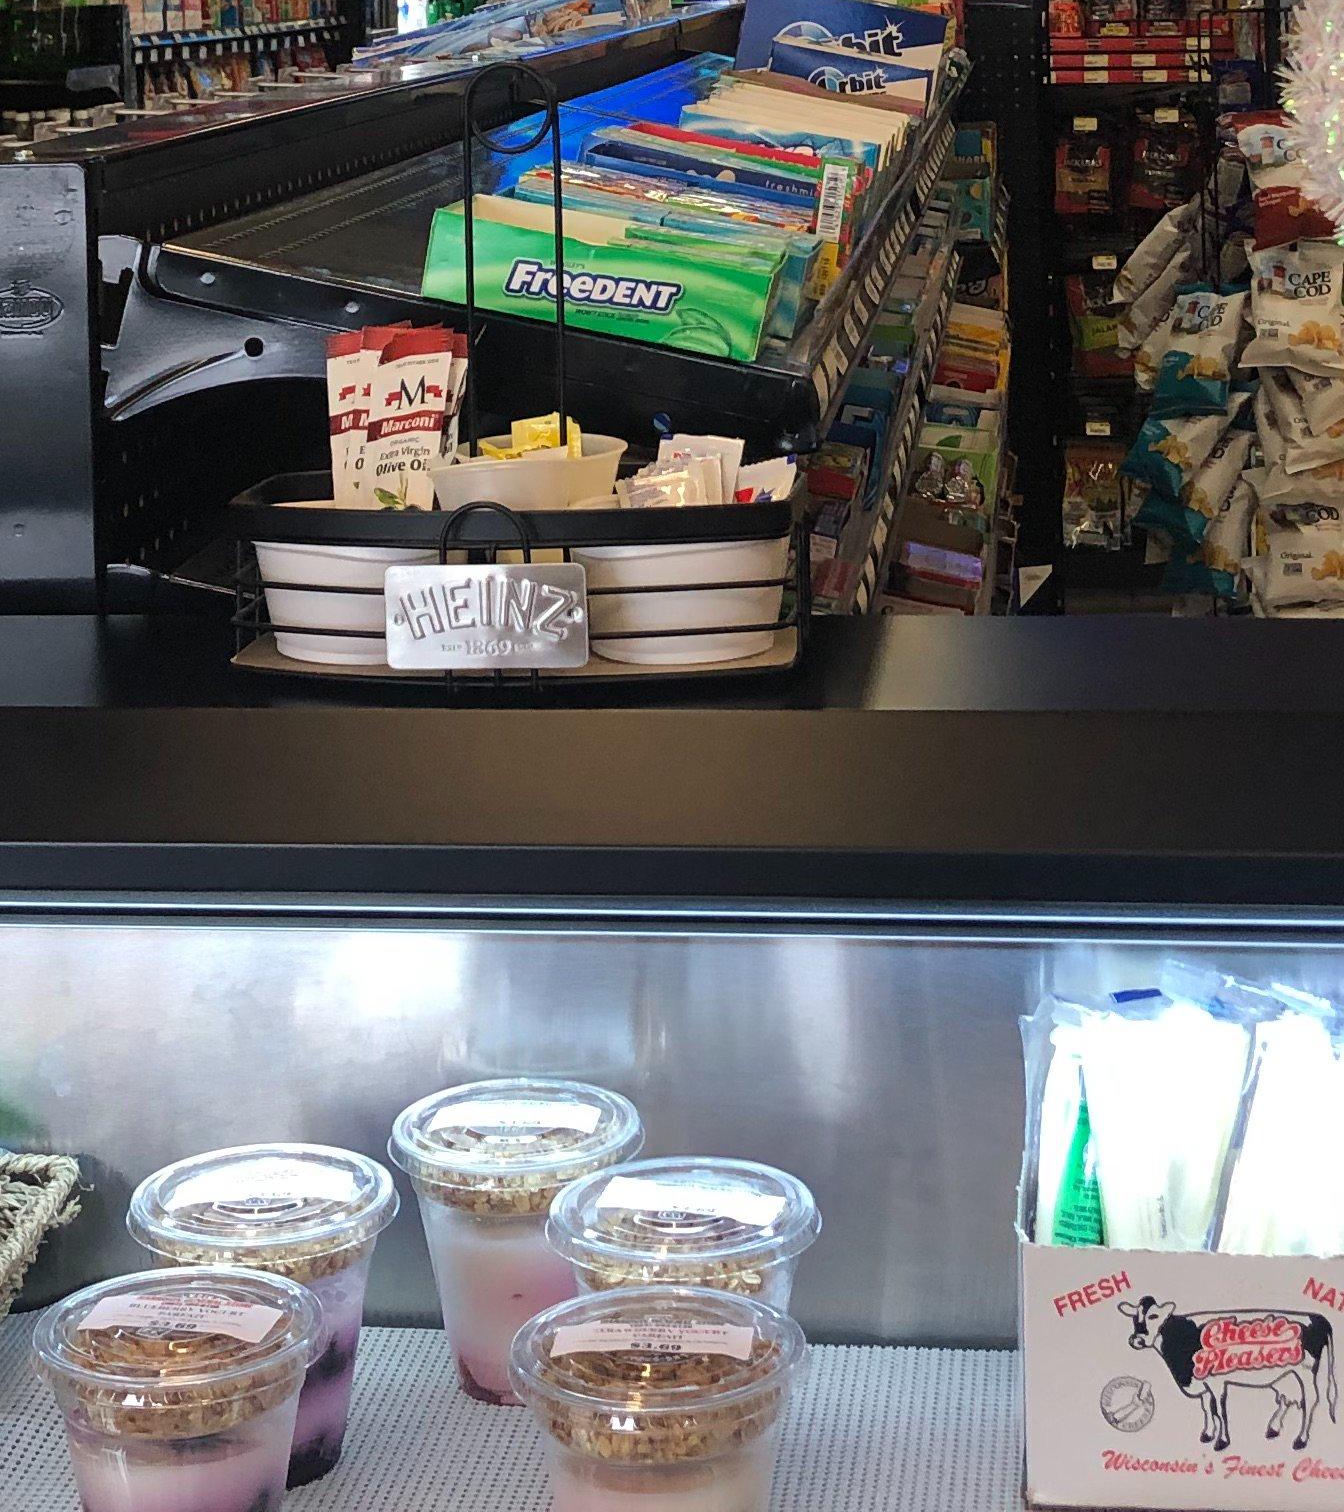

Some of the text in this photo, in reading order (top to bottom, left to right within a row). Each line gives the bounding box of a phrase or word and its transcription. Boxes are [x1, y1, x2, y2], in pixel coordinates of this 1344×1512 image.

[507, 261, 678, 309] FreeDENT
[1288, 271, 1332, 286] CAPE
[1293, 283, 1332, 300] COD
[396, 375, 429, 411] M
[380, 414, 435, 436] Marconi
[379, 446, 431, 461] Extra Virgin
[389, 437, 420, 447] ORGANIC
[375, 460, 407, 477] Olive
[399, 573, 578, 641] HEINZ
[464, 639, 514, 657] 1869
[1053, 1270, 1133, 1318] FRESH
[1202, 1316, 1302, 1347] Cheese
[1194, 1341, 1304, 1380] Pleasers
[1102, 1448, 1215, 1476] Wisconsin's
[1221, 1454, 1286, 1480] Finest
